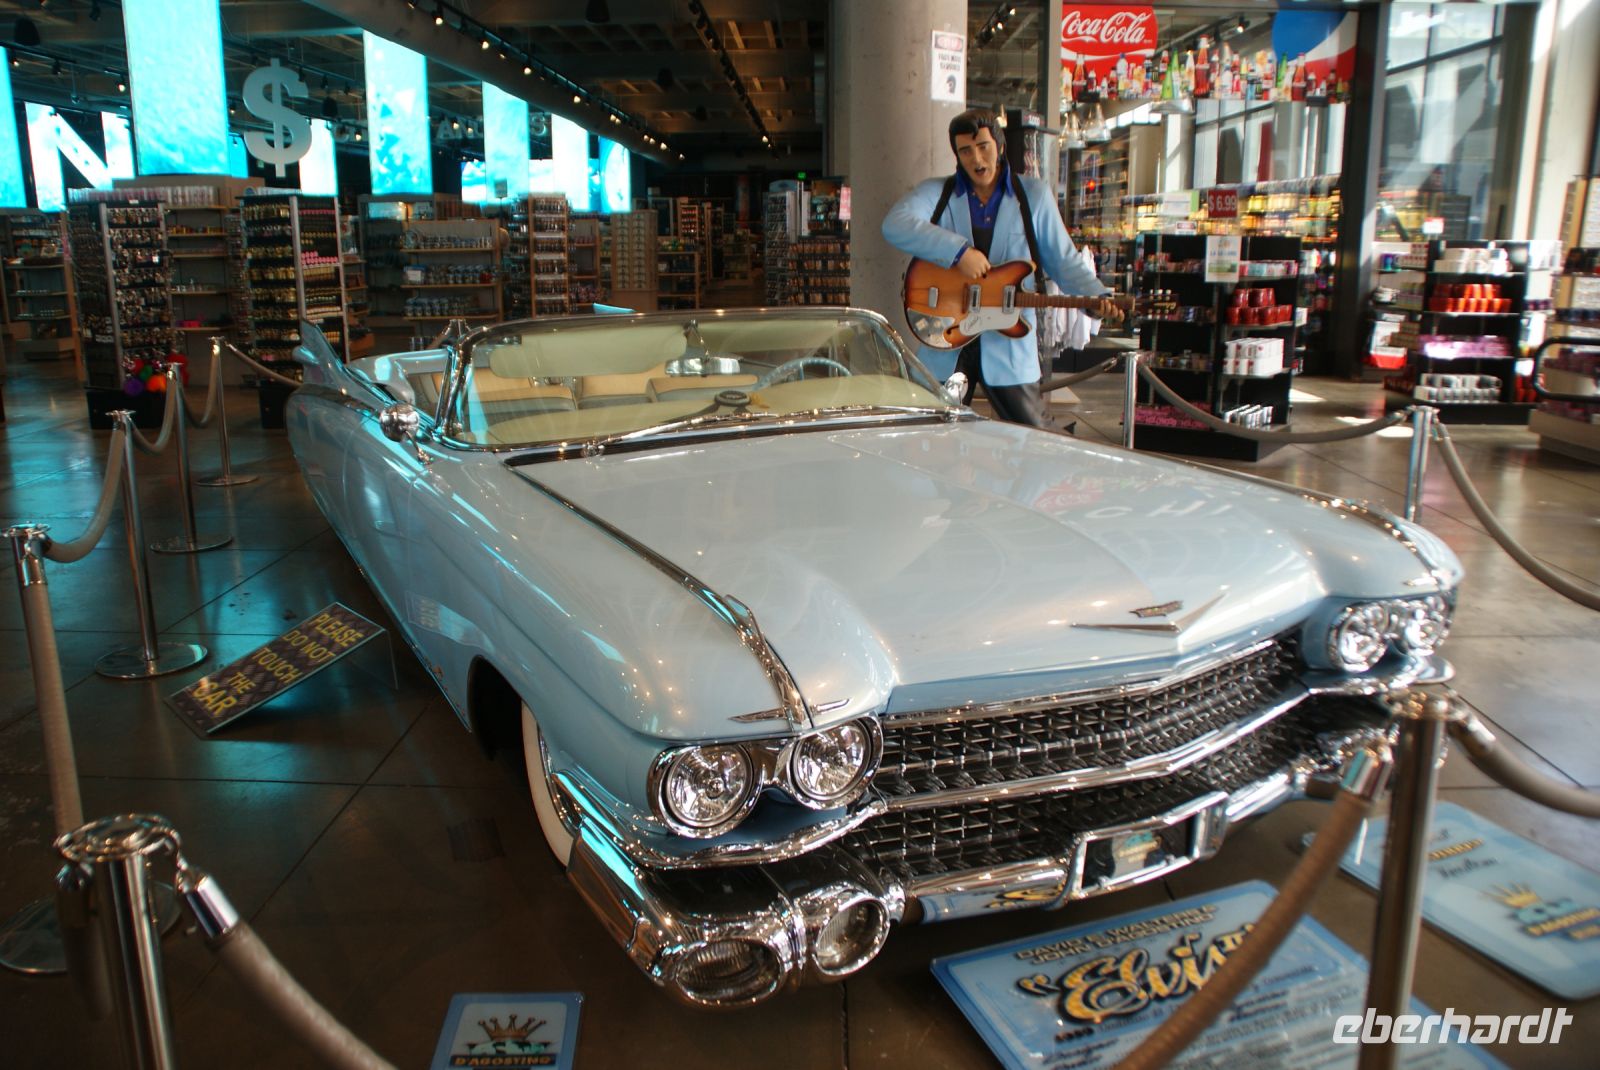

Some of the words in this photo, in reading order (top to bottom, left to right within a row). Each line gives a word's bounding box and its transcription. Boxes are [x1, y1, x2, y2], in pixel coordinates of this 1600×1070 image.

[1061, 11, 1152, 43] Coca-Cola
[282, 629, 308, 647] DO
[303, 641, 336, 663] NOT
[309, 613, 364, 648] PLEASE
[252, 647, 303, 684] TOUCH
[192, 681, 237, 718] CAR
[228, 672, 256, 694] THE
[1017, 936, 1084, 960] DAVID
[1105, 909, 1203, 938] WALTERS
[1031, 942, 1090, 965] JOHN
